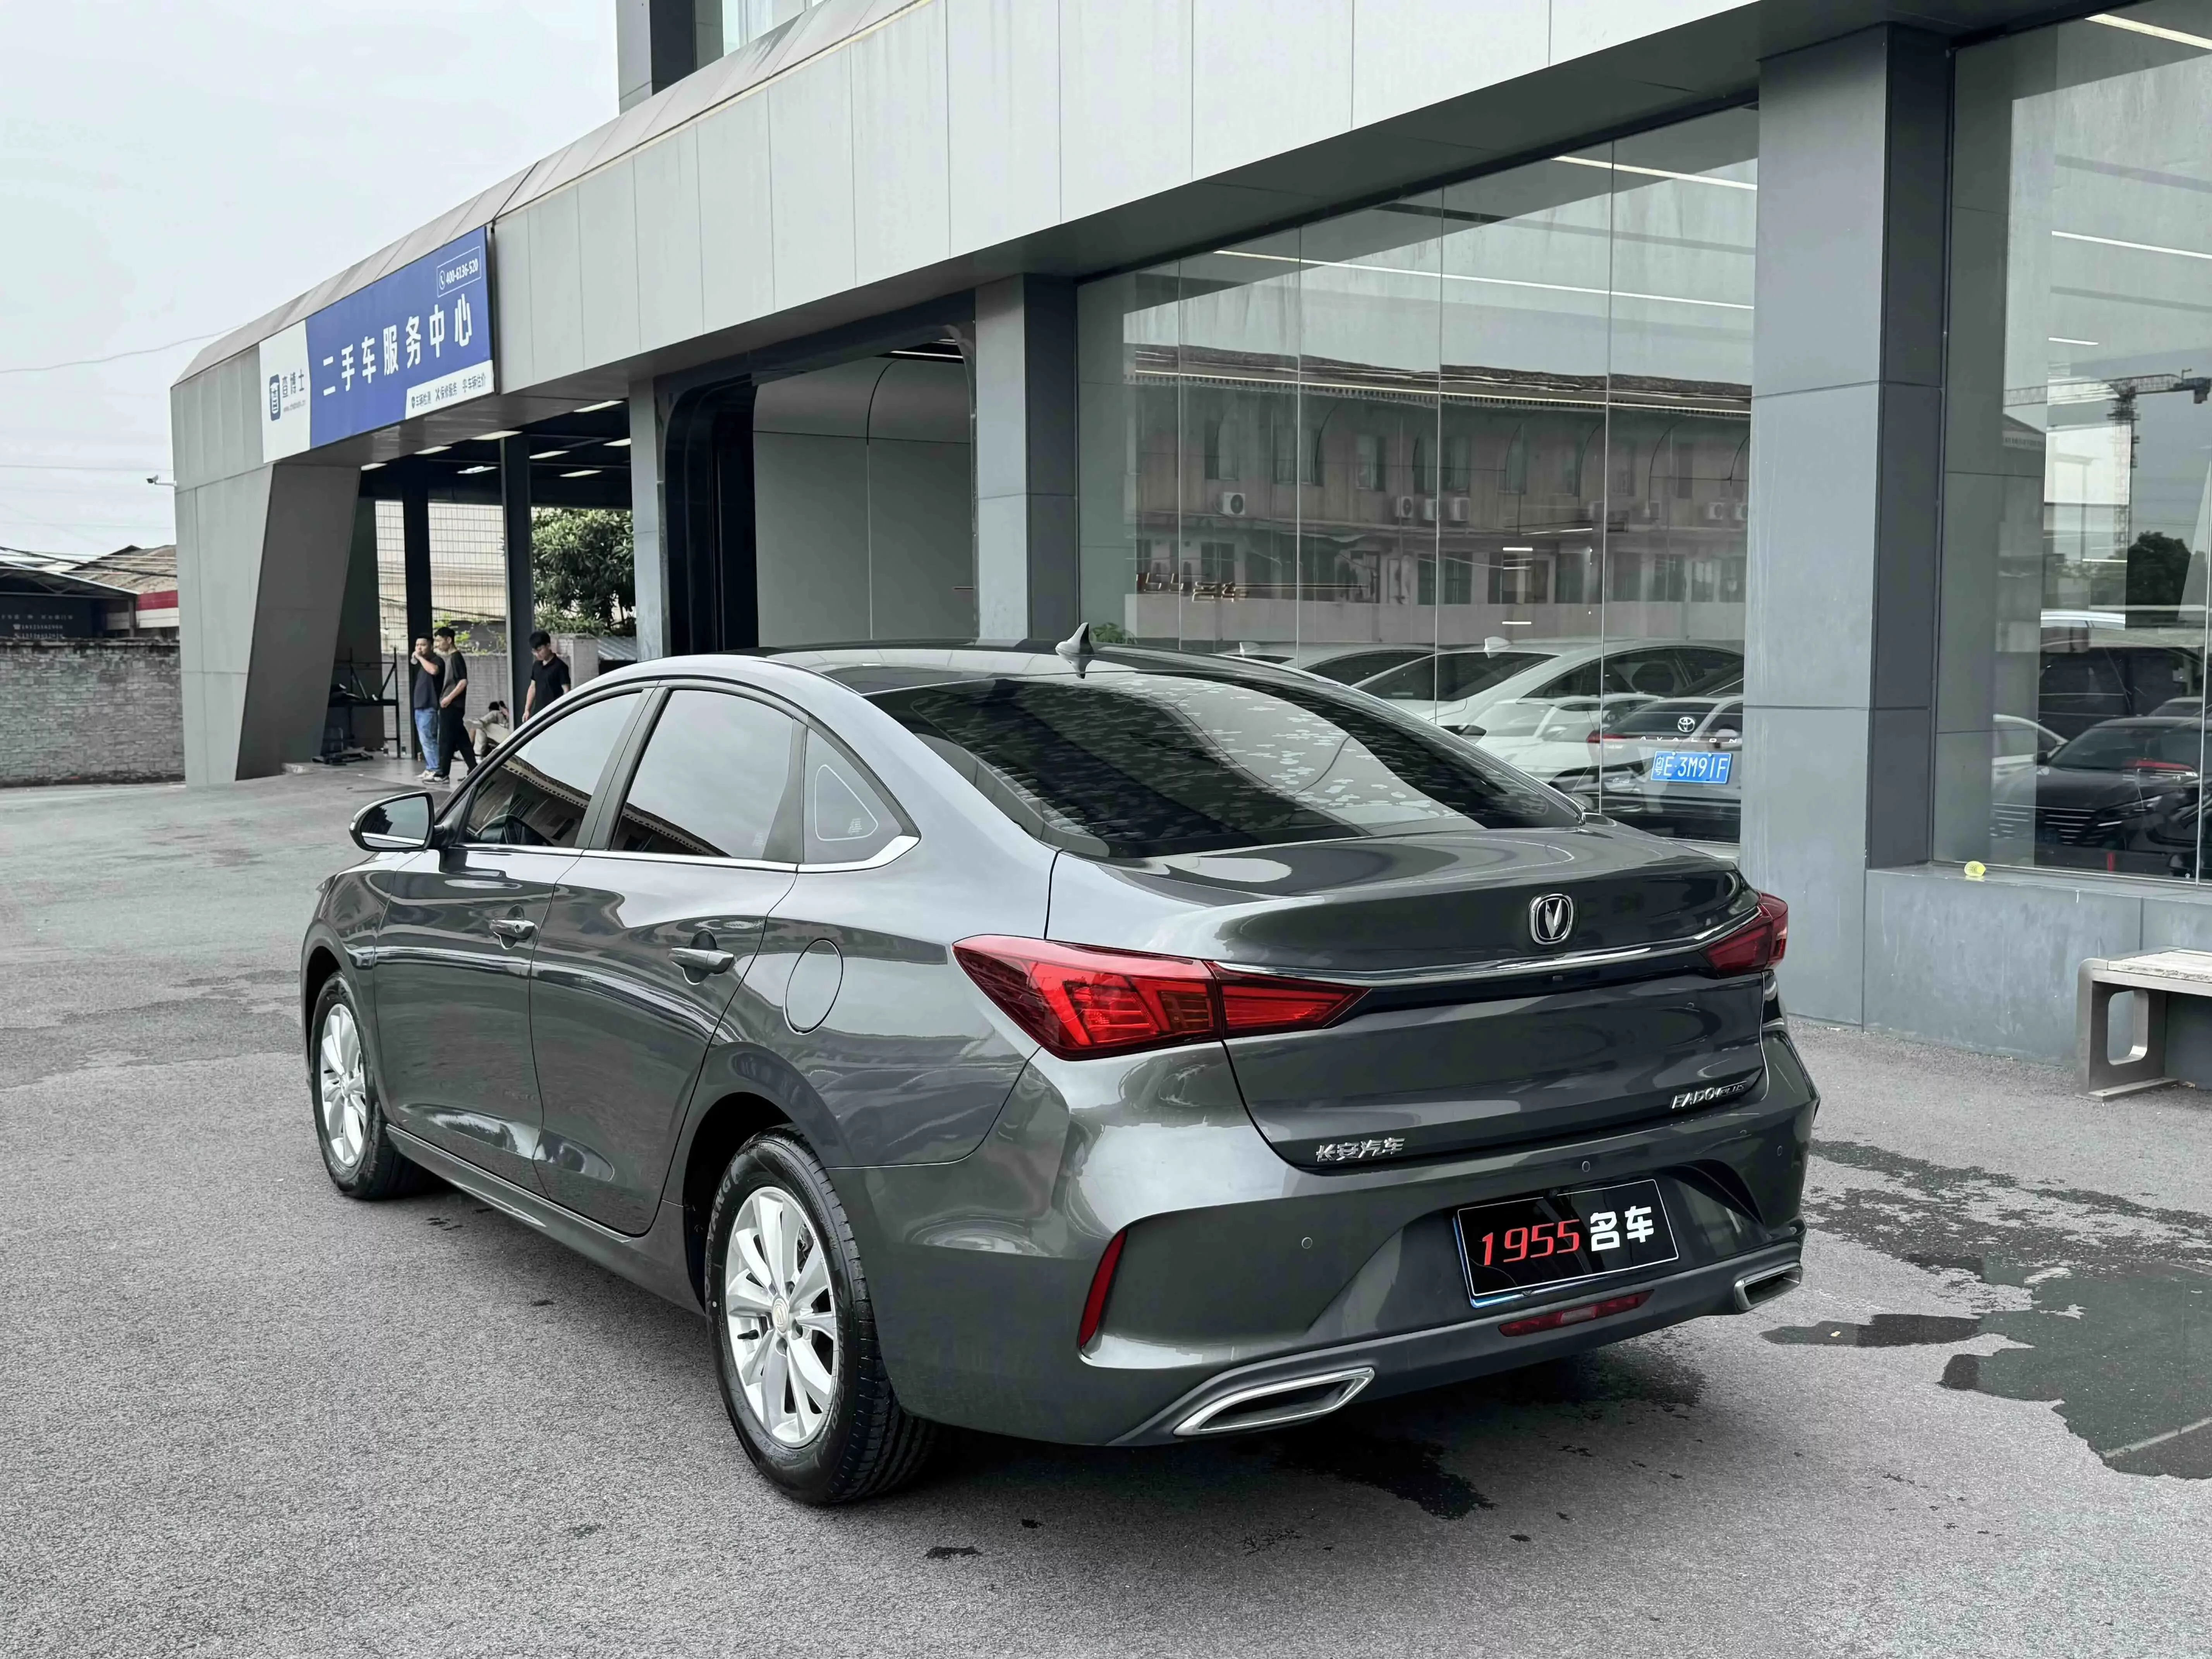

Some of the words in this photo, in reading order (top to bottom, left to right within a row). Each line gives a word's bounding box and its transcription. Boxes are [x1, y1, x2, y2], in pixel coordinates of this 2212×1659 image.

[323, 294, 472, 396] 二手车服务中心
[1671, 1087, 1715, 1109] EADO
[1316, 1137, 1405, 1162] 长安汽车
